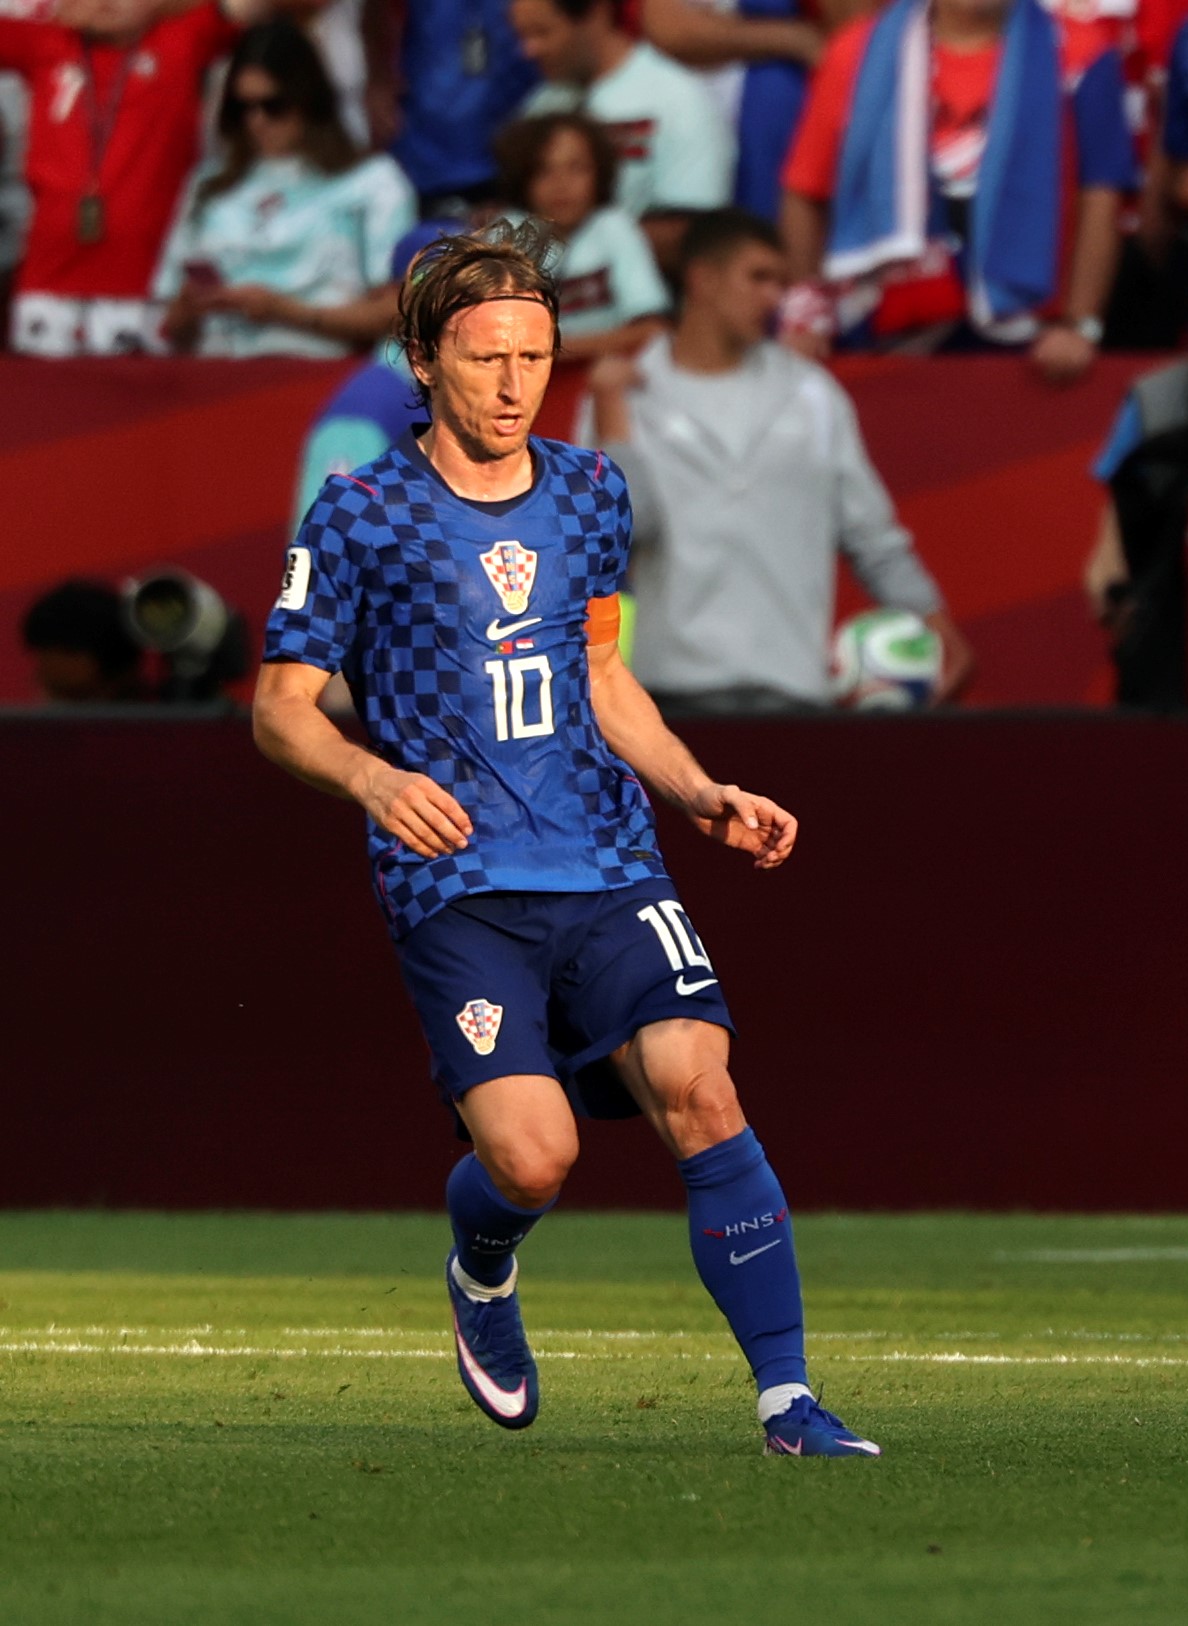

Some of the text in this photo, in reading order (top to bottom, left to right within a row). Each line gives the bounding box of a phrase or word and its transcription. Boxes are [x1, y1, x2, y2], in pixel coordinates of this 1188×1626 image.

[485, 655, 554, 741] 10
[637, 899, 713, 972] 10
[725, 1212, 774, 1237] HNS
